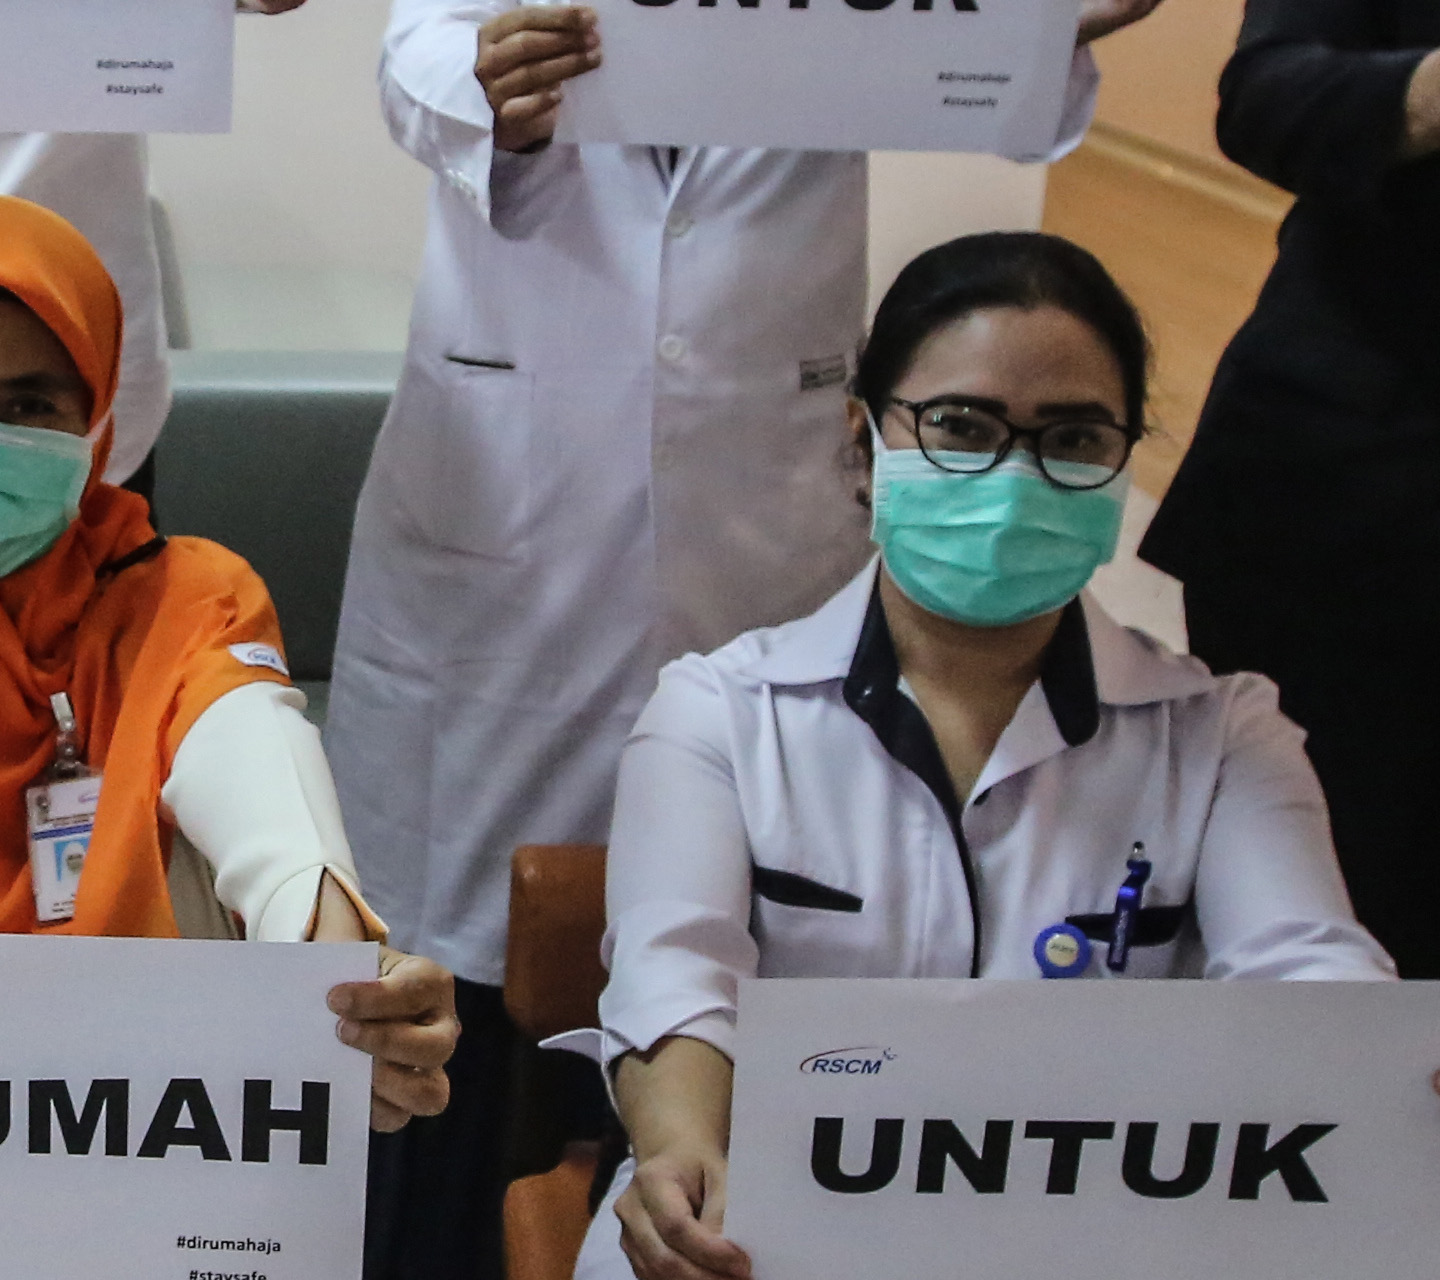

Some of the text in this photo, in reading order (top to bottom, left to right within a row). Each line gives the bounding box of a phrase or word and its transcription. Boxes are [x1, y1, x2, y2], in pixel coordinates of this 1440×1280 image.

[812, 1058, 882, 1075] RSCM
[811, 1117, 1338, 1203] UNTUK
[177, 1236, 281, 1255] #dirumahaja
